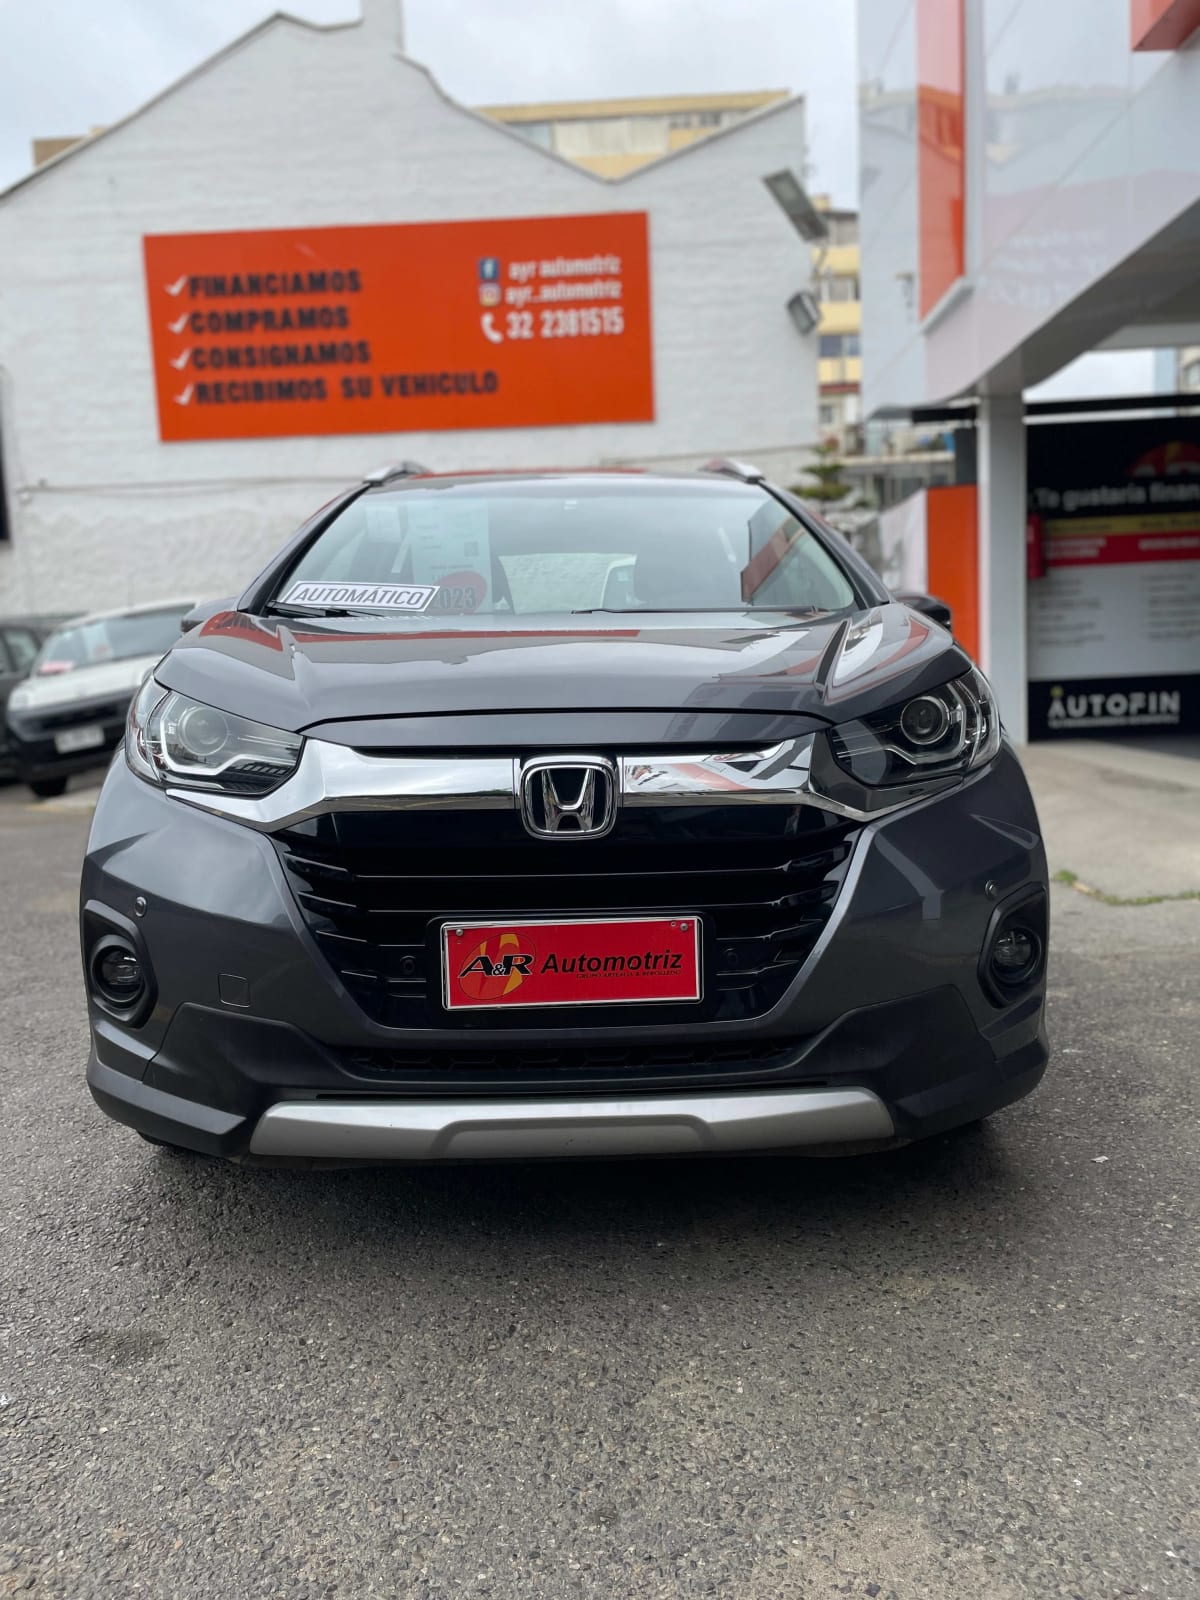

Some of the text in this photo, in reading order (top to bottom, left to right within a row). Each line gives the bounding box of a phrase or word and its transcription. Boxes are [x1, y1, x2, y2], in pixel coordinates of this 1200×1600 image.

[540, 254, 621, 278] automotriz
[190, 269, 361, 299] FINANCIAMOS
[191, 306, 348, 333] COMPRAMOS
[506, 312, 533, 338] 32
[193, 341, 370, 369] CONSIGNAMOS
[197, 371, 499, 404] RECIBIMOS SU VEHICULO
[293, 586, 424, 606] AUTOMÁTICO
[1048, 689, 1181, 719] AUTOFIN
[458, 949, 682, 978] A&R Automotriz
